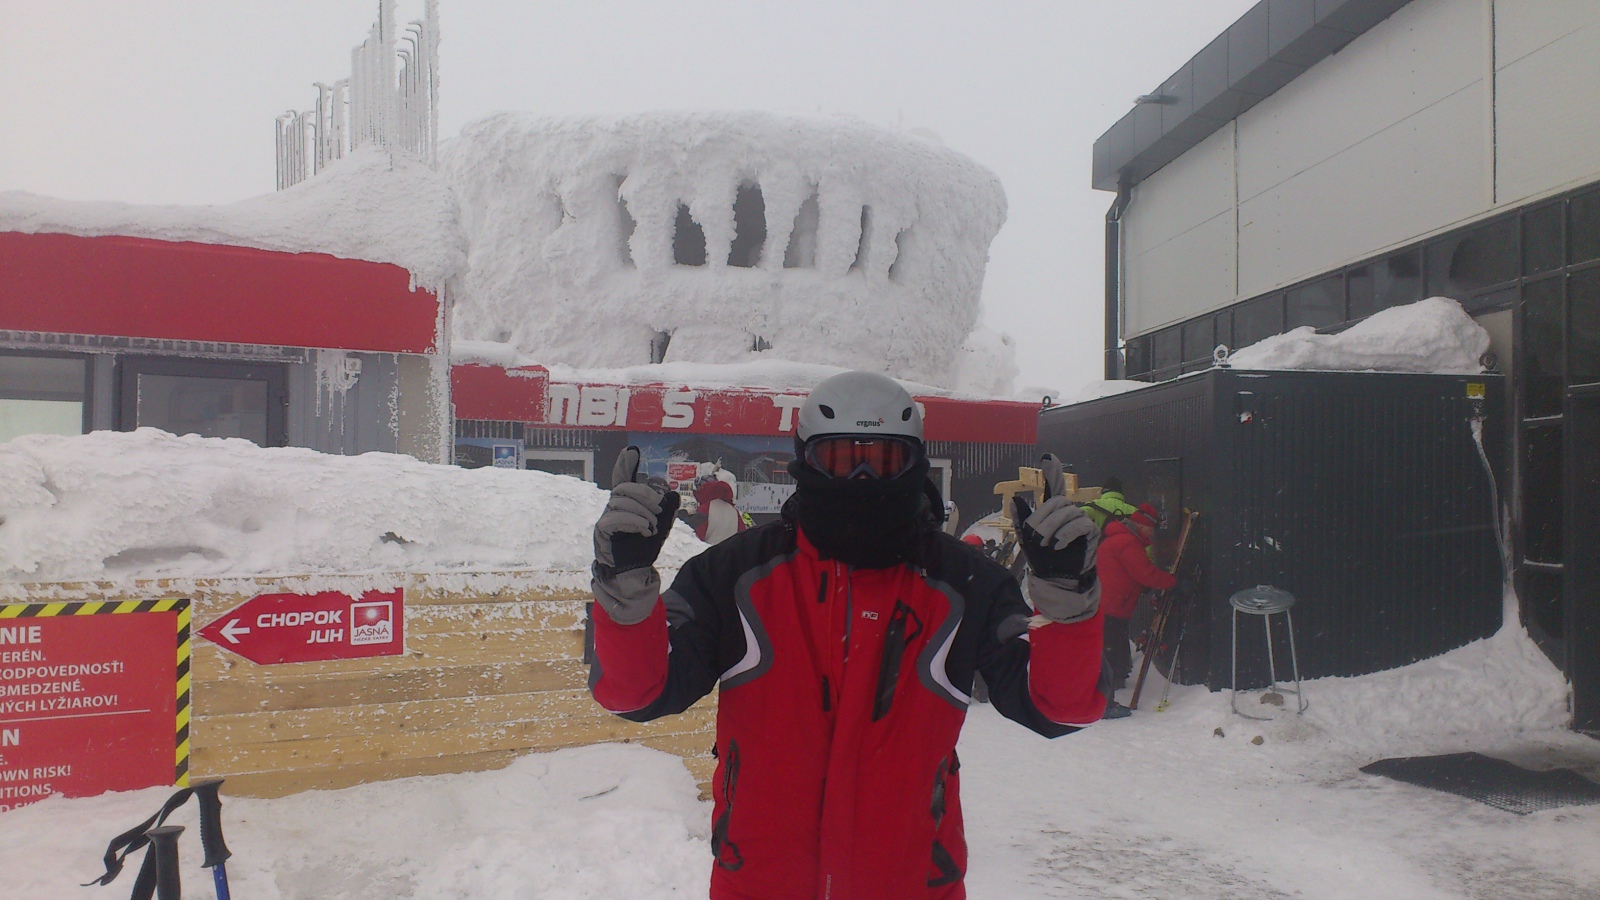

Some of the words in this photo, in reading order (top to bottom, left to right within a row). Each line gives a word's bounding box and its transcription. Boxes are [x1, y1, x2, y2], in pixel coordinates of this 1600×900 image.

[856, 419, 881, 428] cygnus
[257, 610, 343, 628] CHOPOK
[0, 626, 41, 644] NIE
[306, 628, 344, 644] JUH
[354, 625, 389, 637] JASNÁ
[0, 648, 46, 663] ERÉN.
[0, 660, 124, 680] ODPOVEDNOSŤ!
[40, 695, 118, 711] LYŽIAROV!
[3, 729, 19, 746] N
[0, 768, 28, 781] WN
[33, 765, 71, 779] RISK!
